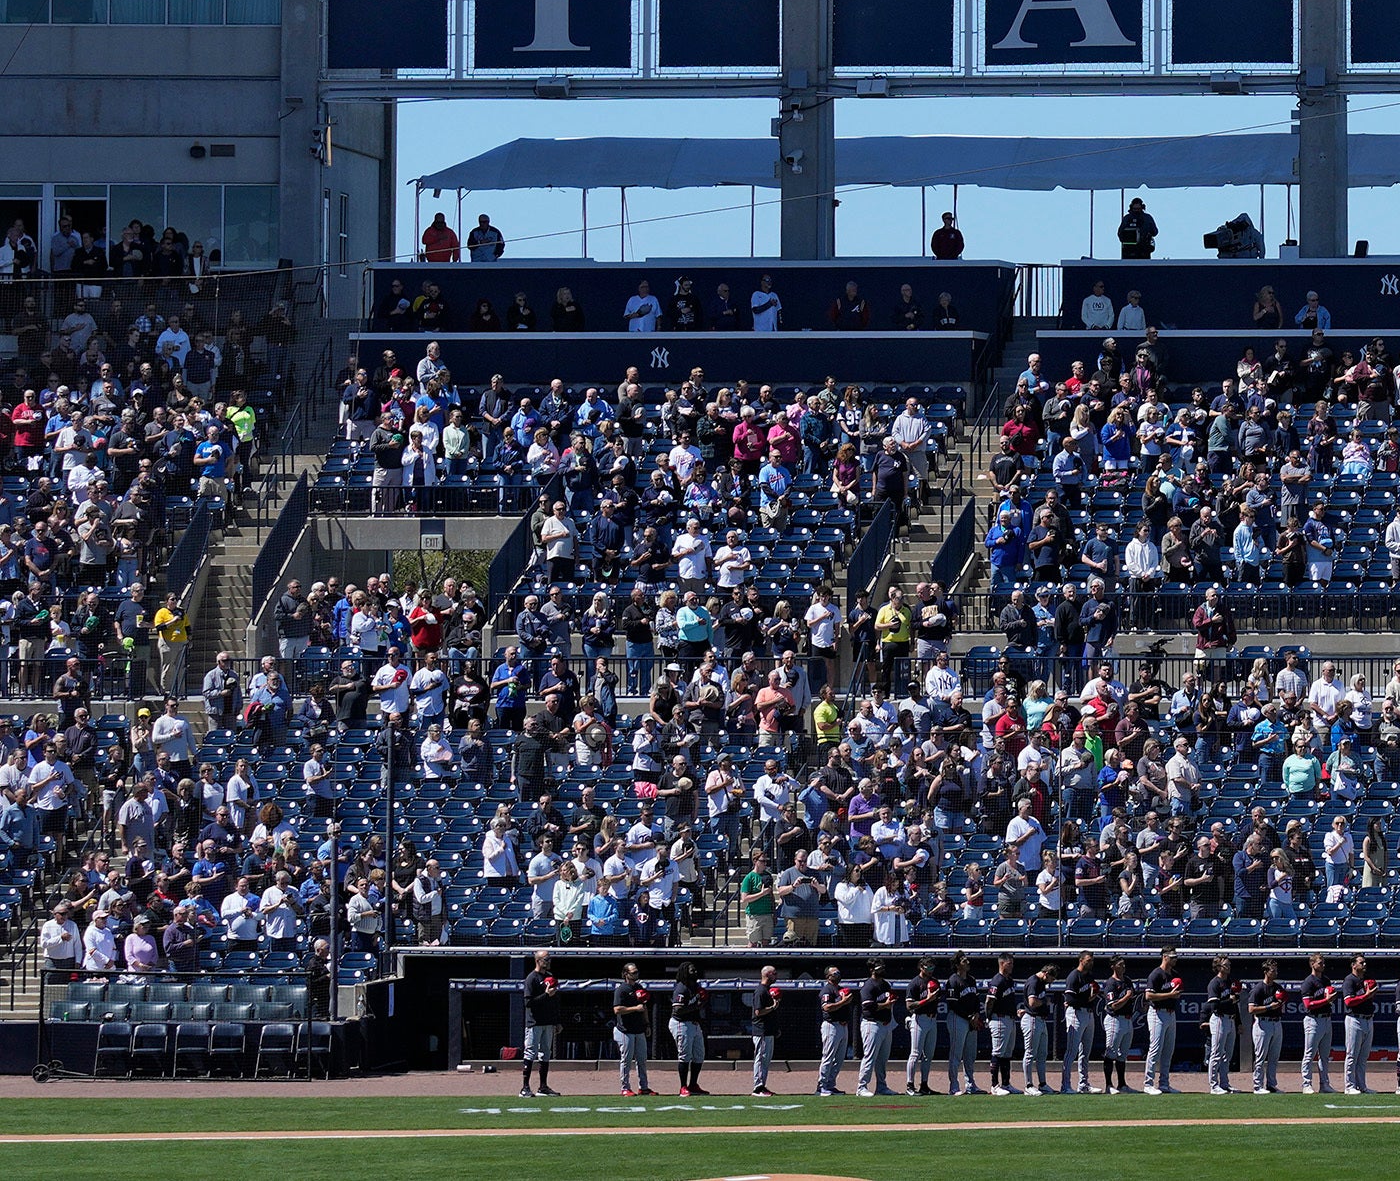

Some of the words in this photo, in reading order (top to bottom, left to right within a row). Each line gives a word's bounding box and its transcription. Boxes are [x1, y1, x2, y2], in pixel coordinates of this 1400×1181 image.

[1380, 274, 1399, 296] NY
[650, 346, 670, 369] NY
[425, 537, 439, 548] EXIT
[938, 675, 958, 691] NY
[458, 1103, 804, 1115] AnyDesk
